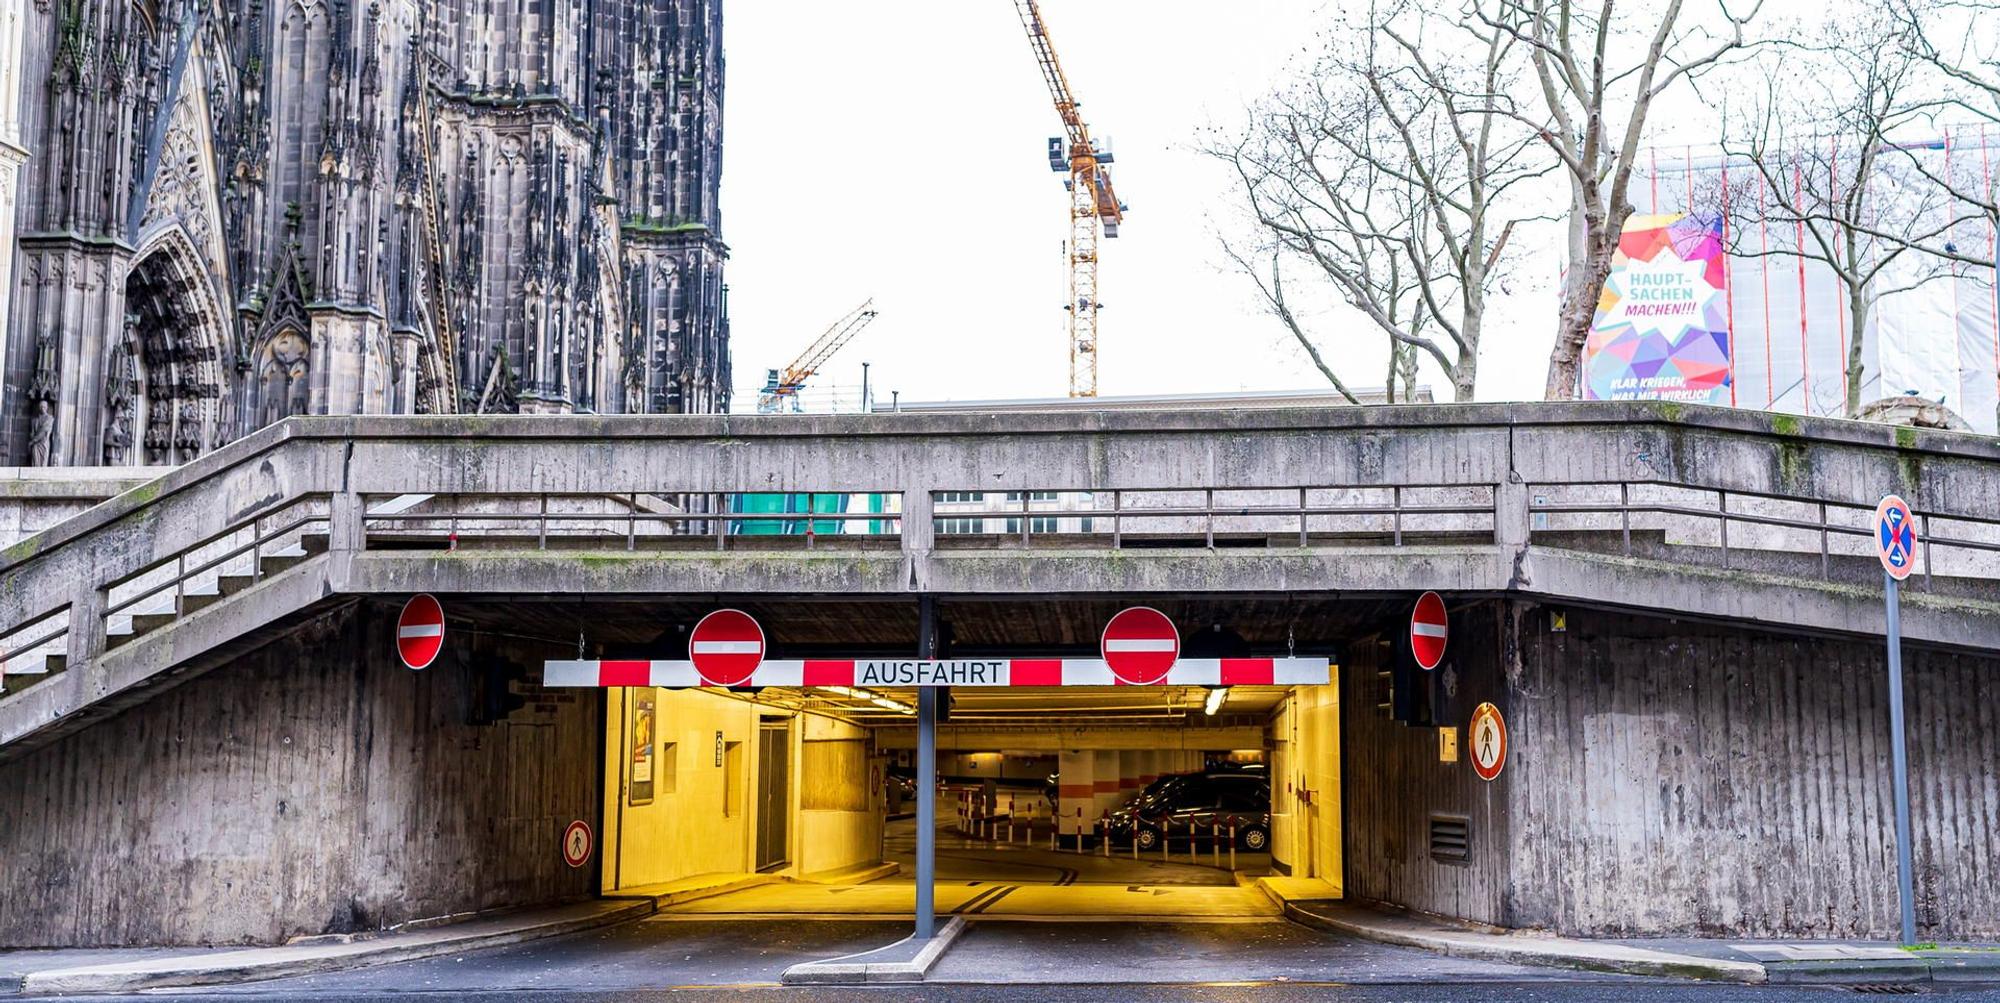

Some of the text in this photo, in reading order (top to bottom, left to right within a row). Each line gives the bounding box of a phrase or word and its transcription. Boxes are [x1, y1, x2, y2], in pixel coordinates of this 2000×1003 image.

[1630, 273, 1692, 286] HAUPT-
[1630, 288, 1693, 300] SACHEN
[1625, 302, 1697, 316] MACHEN!!!
[1610, 377, 1637, 389] KLAR
[1659, 389, 1712, 401] WIRKLICH
[862, 662, 1002, 683] AUSFAHRT
